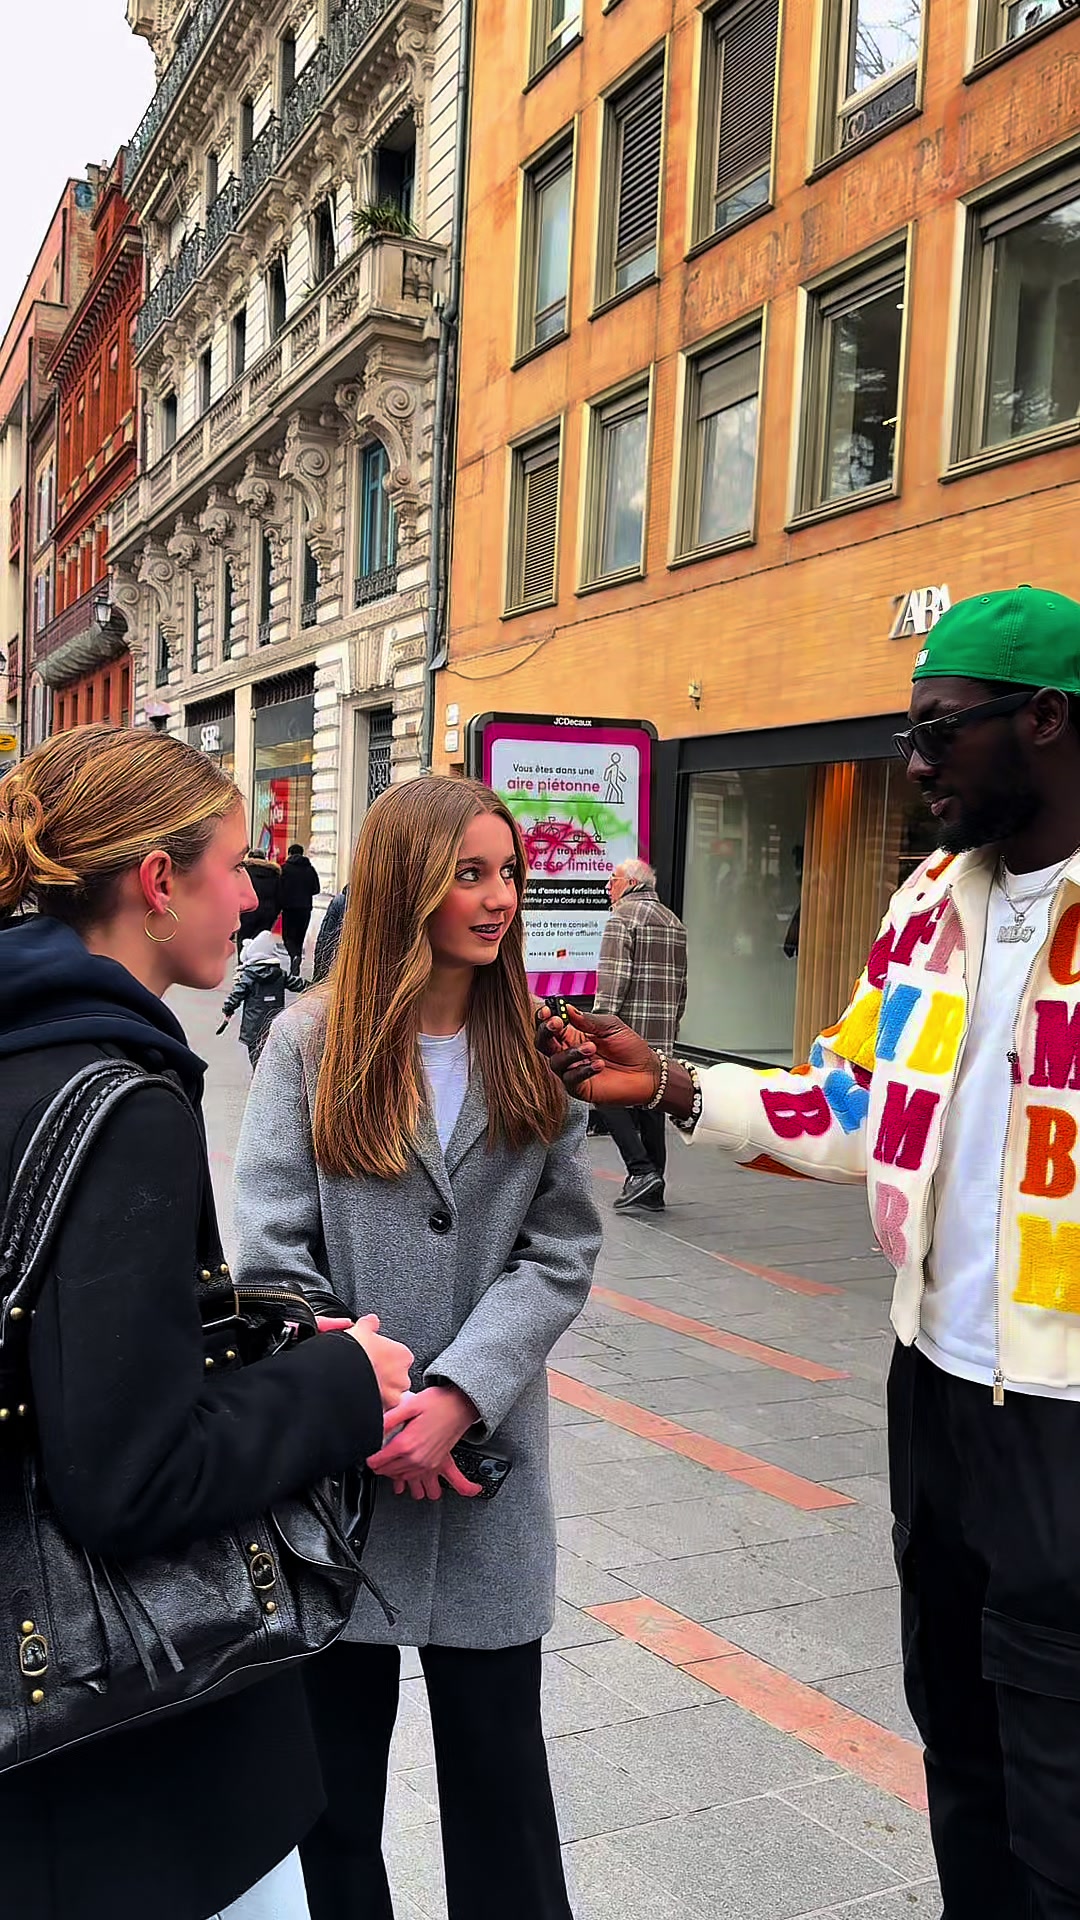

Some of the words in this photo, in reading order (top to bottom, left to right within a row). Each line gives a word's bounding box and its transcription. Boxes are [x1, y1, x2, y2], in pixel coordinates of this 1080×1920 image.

[553, 717, 592, 727] JCDecaux
[513, 763, 533, 773] Vous
[535, 764, 553, 774] êtes
[556, 766, 576, 775] dans
[507, 778, 533, 790] aire
[537, 778, 601, 793] piétonne
[568, 859, 613, 871] limitée
[1019, 1104, 1077, 1198] B
